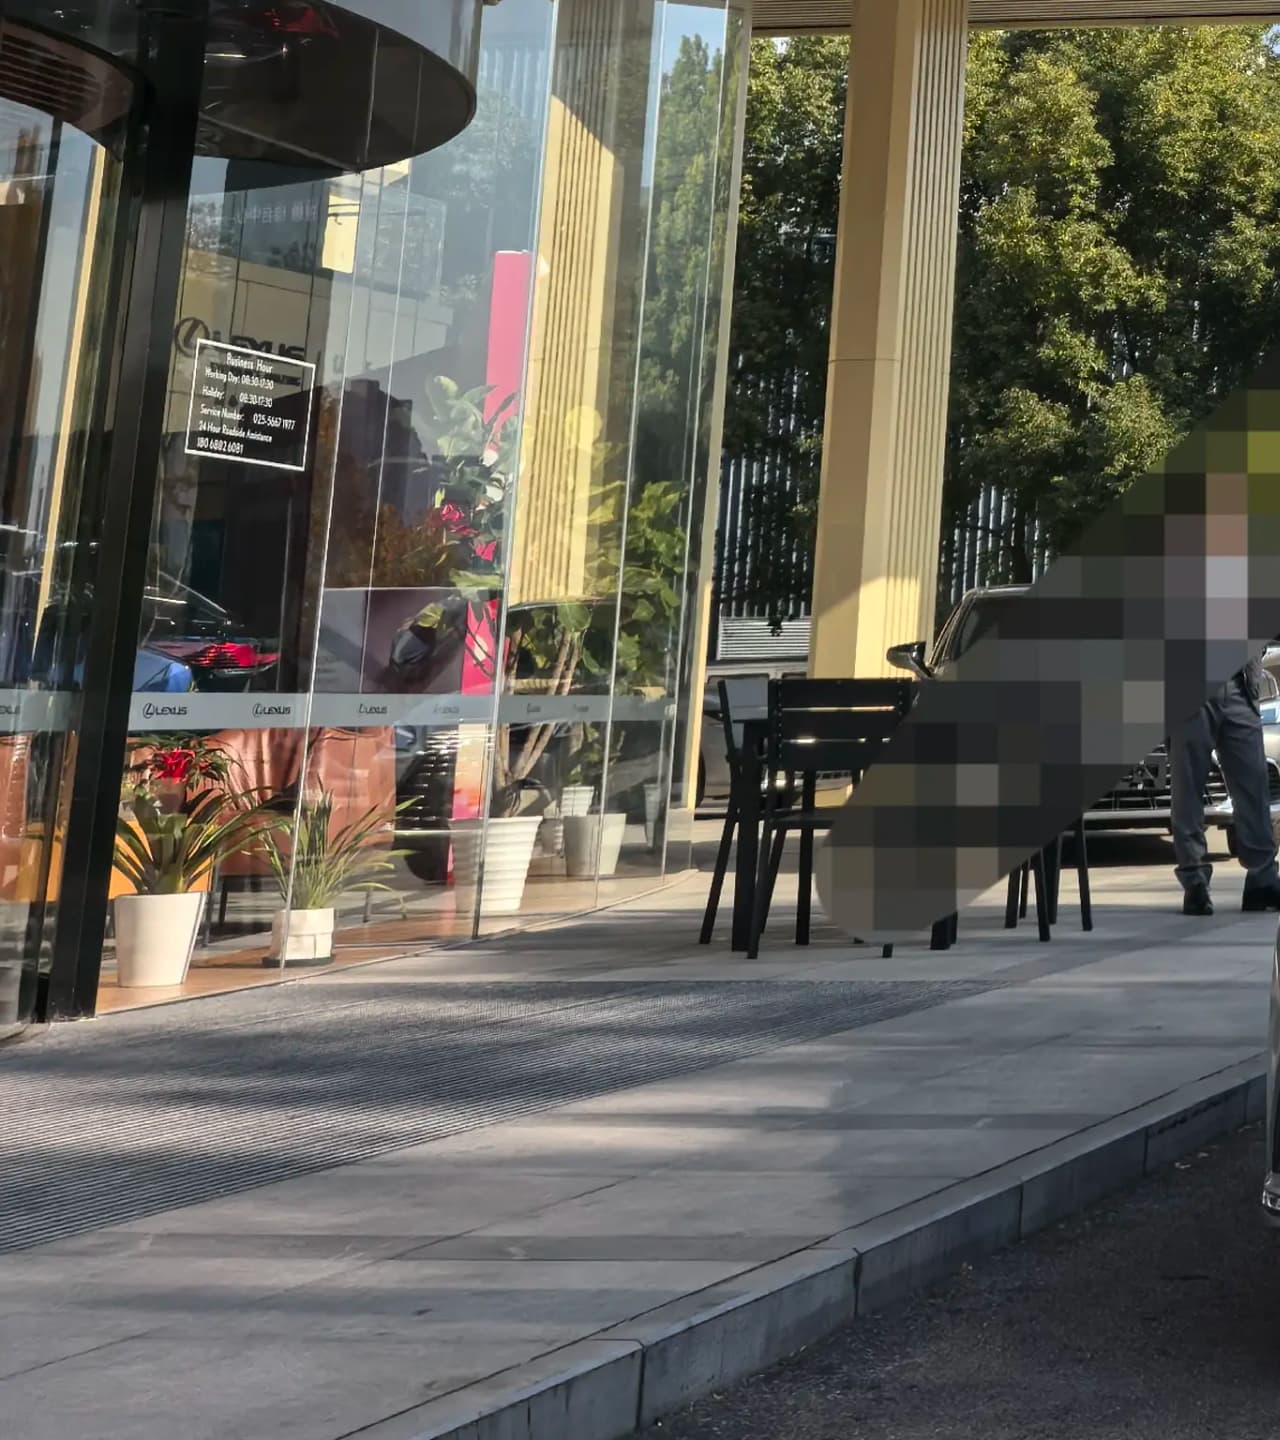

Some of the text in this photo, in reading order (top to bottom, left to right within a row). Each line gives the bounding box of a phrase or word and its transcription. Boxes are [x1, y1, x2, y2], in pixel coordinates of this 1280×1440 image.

[226, 352, 274, 373] Business Hour
[205, 366, 227, 383] Working
[200, 403, 221, 417] Service
[207, 423, 222, 433] Hour
[155, 705, 188, 715] LEXUS
